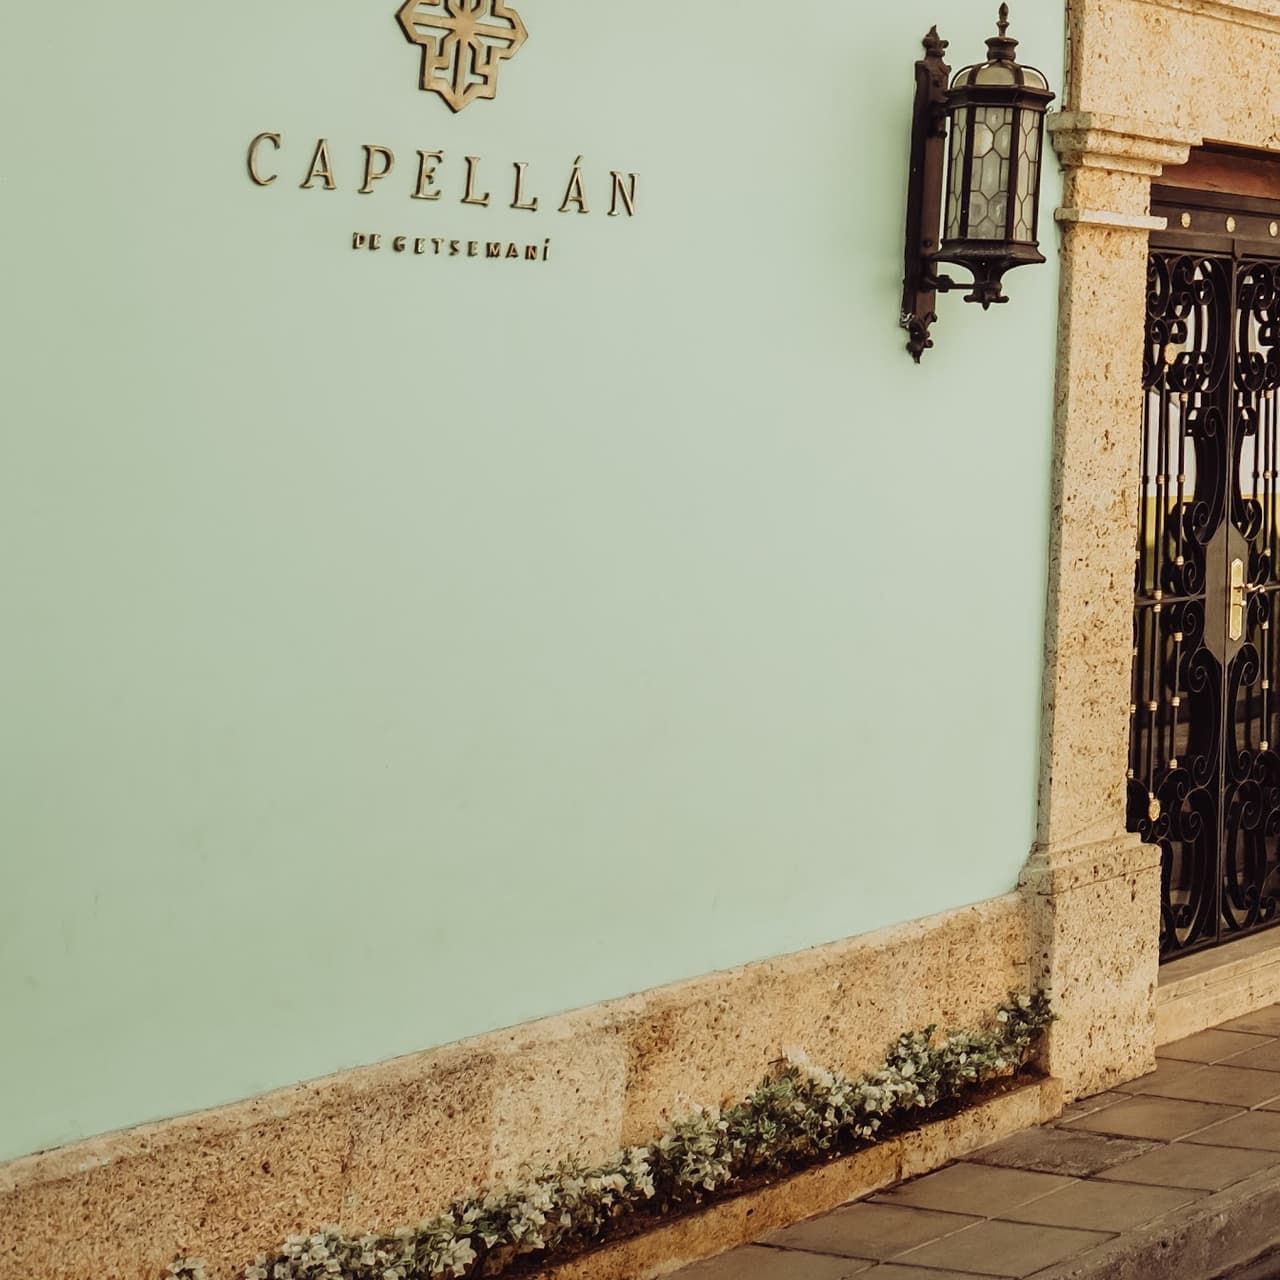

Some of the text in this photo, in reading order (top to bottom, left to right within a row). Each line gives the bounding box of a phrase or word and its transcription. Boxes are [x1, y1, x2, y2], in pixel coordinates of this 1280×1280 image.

[246, 132, 640, 218] CAPELLÁN
[352, 232, 552, 263] DE GETSEMANÍ
